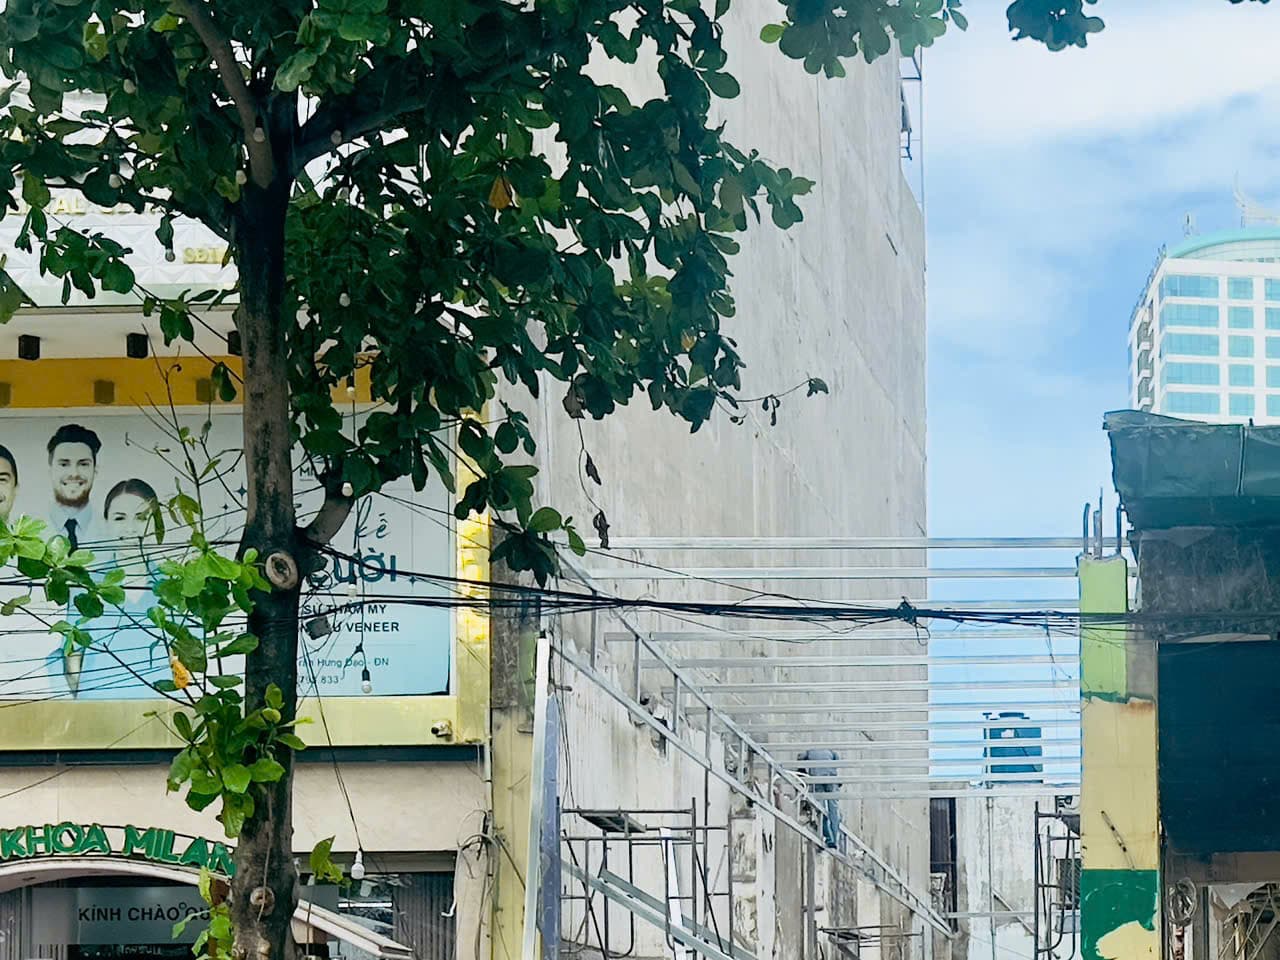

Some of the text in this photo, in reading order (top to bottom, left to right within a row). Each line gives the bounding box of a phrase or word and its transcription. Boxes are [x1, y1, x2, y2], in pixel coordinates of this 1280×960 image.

[346, 622, 400, 632] VENEER
[0, 822, 237, 879] KHOA MILAN
[79, 902, 121, 921] KÍNH
[128, 902, 180, 921] CHÀO
